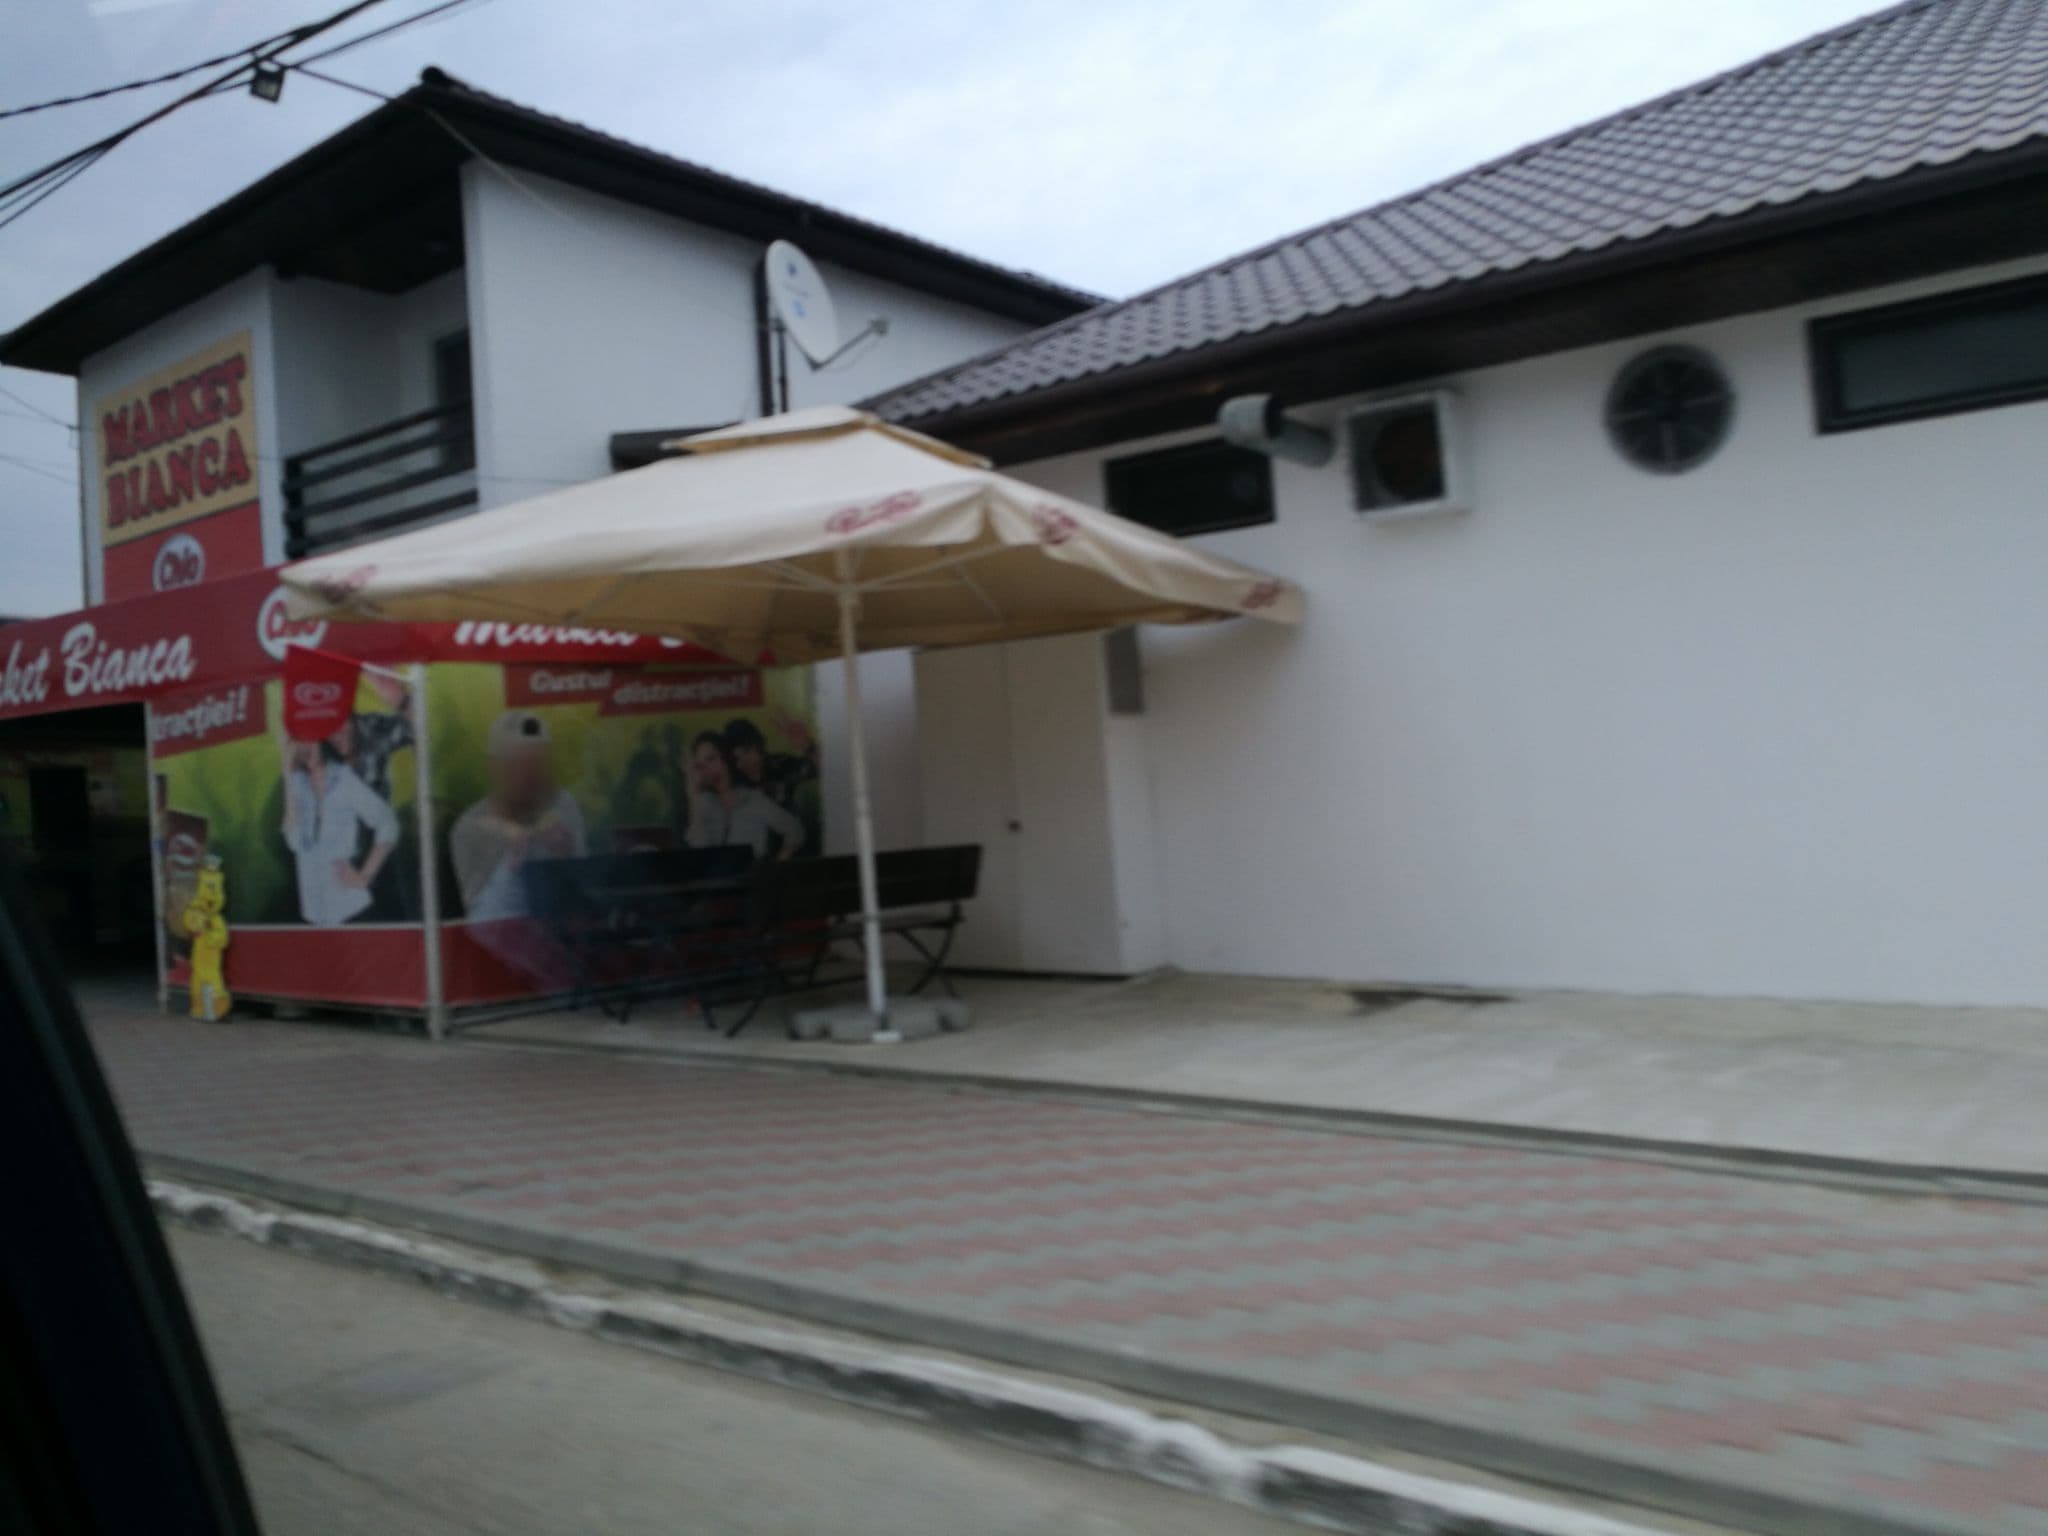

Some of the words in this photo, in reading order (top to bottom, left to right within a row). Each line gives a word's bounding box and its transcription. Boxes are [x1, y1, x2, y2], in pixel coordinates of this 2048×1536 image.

[103, 353, 246, 466] MARKET
[106, 428, 250, 528] BIANCA
[0, 640, 50, 705] ket
[61, 622, 198, 696] Bianca
